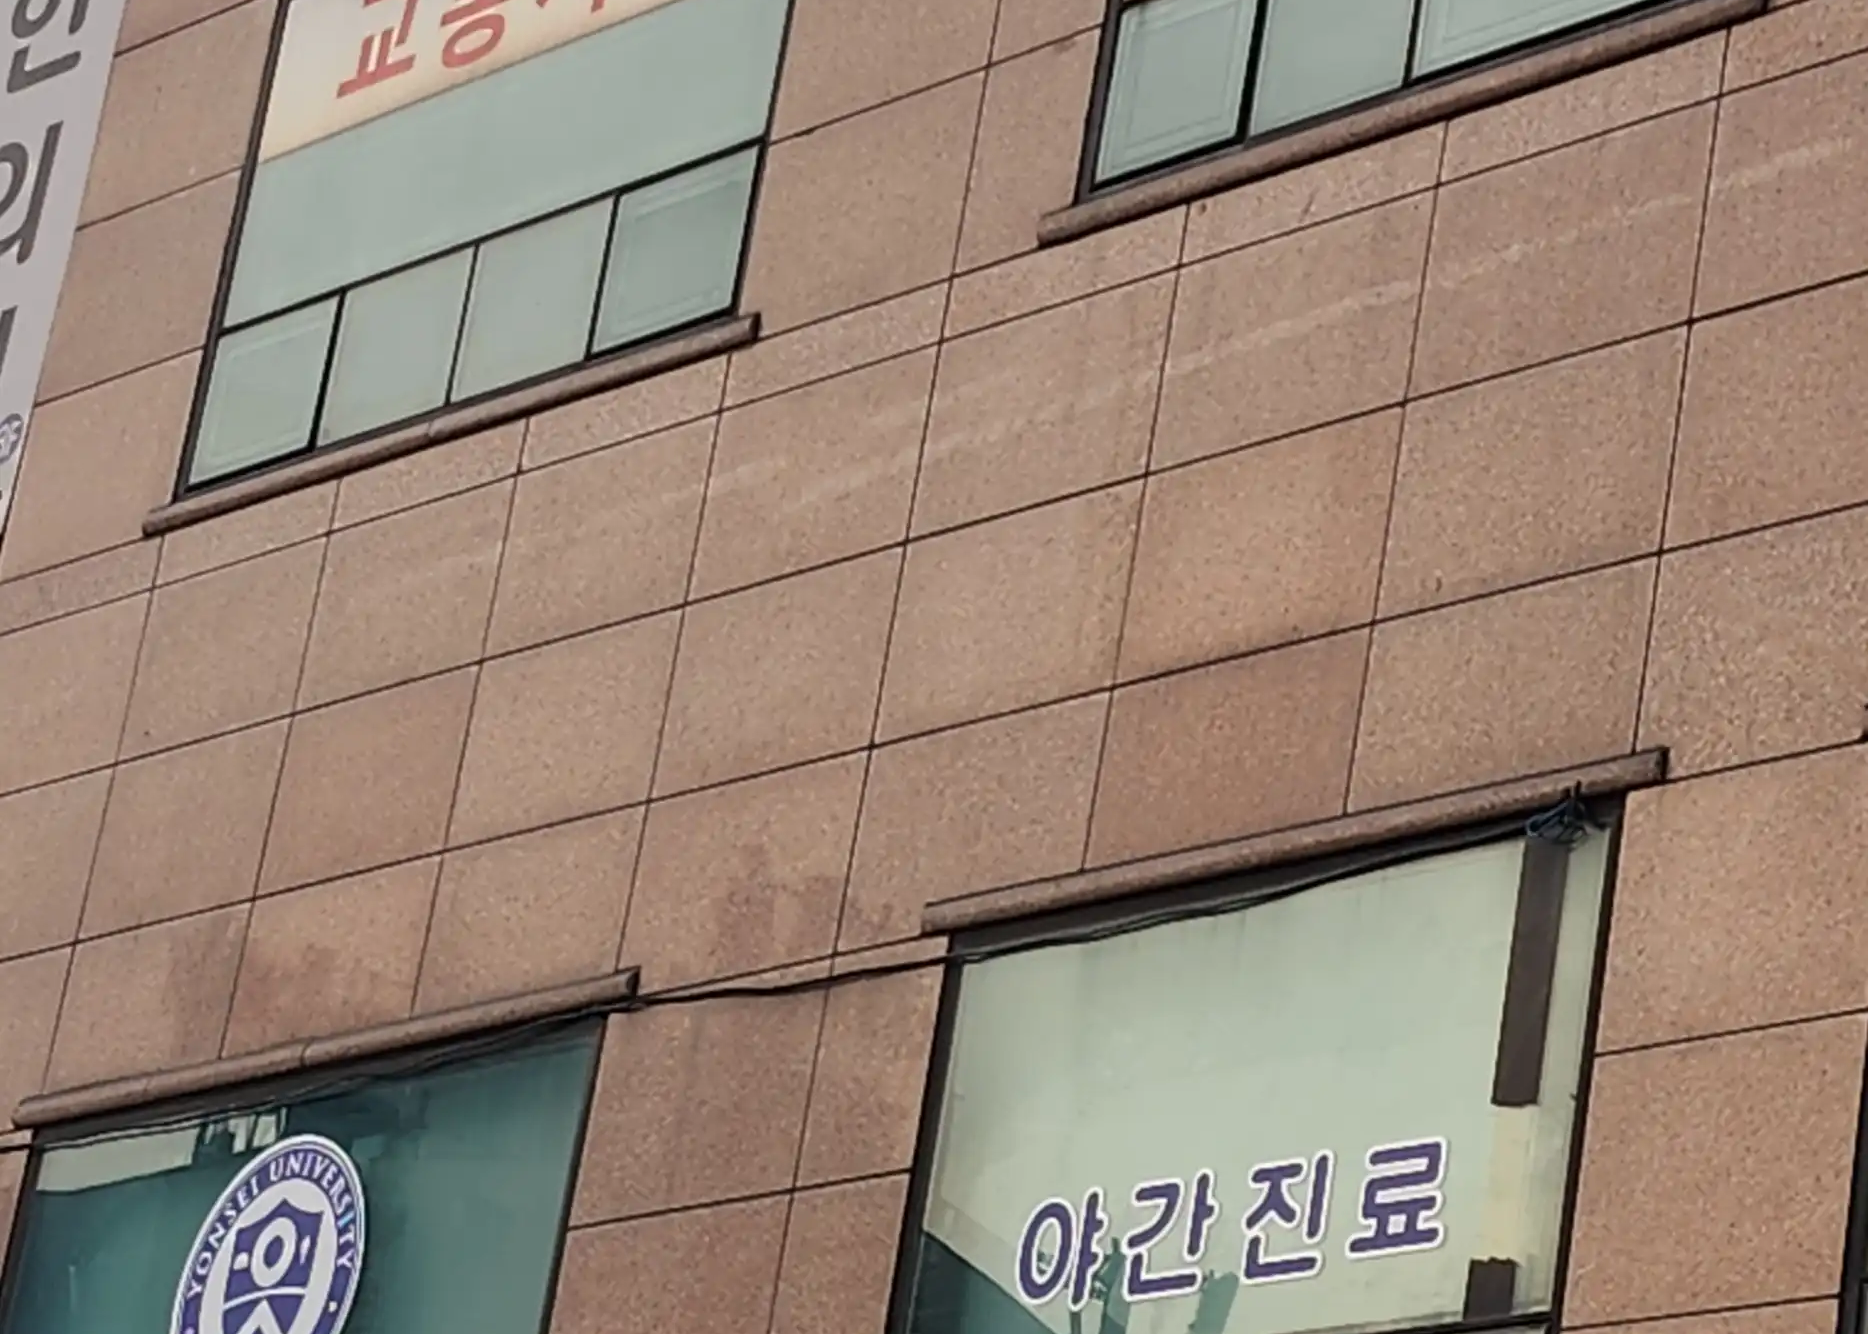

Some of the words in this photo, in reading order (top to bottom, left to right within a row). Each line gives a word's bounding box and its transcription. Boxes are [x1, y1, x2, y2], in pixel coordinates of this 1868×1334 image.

[186, 1179, 260, 1299] YONSEI
[268, 1153, 355, 1269] UNIVERSITY
[1015, 1137, 1449, 1309] 야간진료
